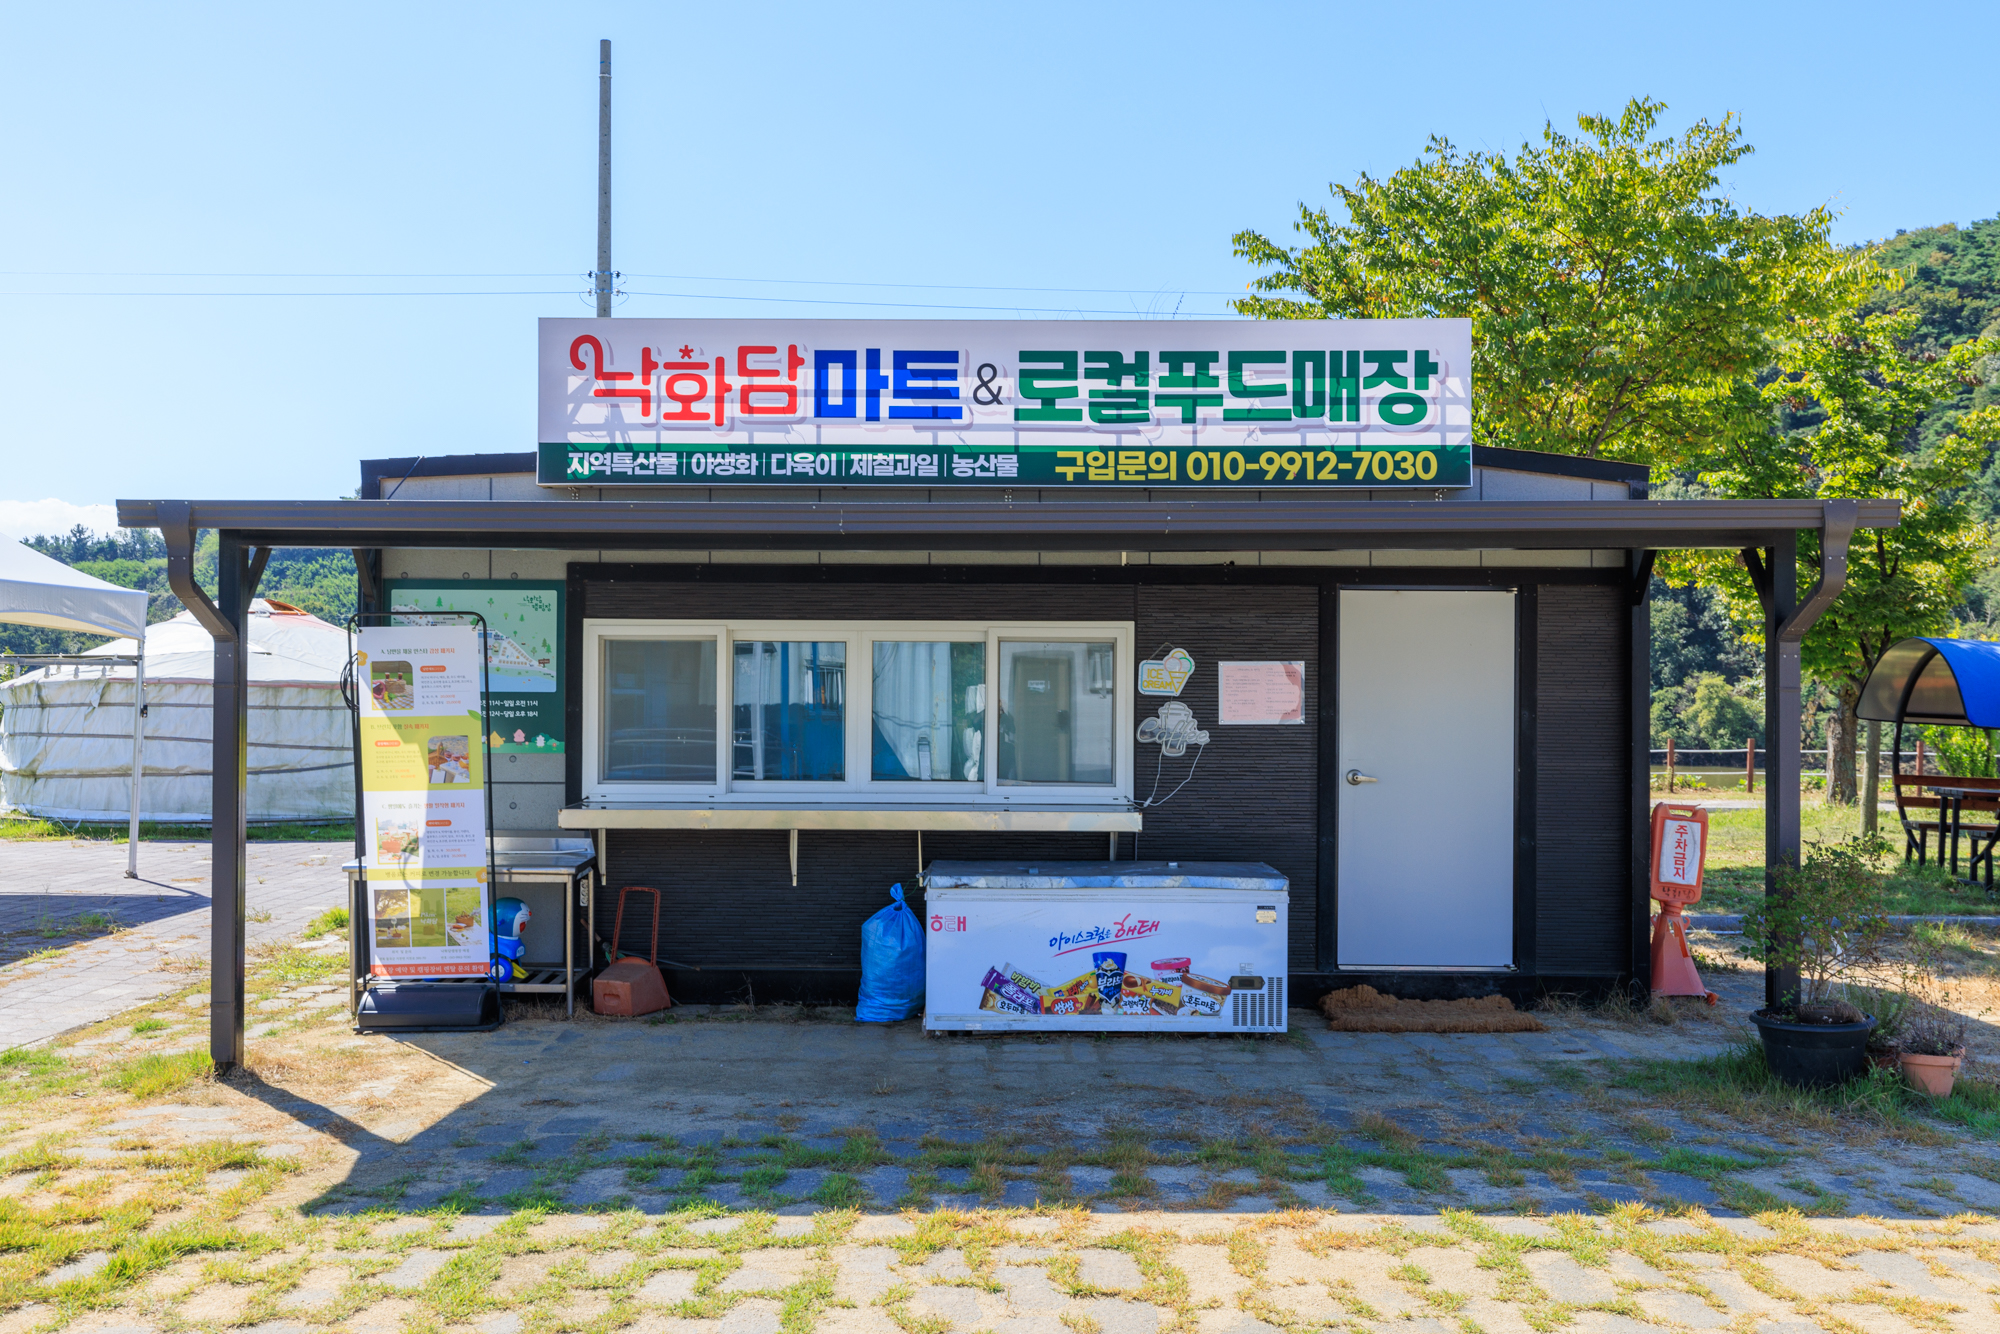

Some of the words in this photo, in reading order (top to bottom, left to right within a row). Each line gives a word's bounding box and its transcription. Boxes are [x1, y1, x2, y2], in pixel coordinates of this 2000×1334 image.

[570, 334, 805, 427] 낙화담
[813, 348, 963, 422] 마트
[972, 362, 1003, 406] &
[1014, 350, 1438, 425] 로컬푸드매장
[567, 452, 678, 475] 지역특산물
[691, 453, 758, 476] 야생화
[771, 453, 836, 476] 다육이
[850, 453, 938, 477] 제철과일
[952, 454, 1018, 477] 농산물
[1055, 451, 1177, 481] 구입문의
[1186, 451, 1438, 481] 010-9912-7030
[532, 603, 551, 612] 캠핑장
[1142, 679, 1172, 690] CREAM
[1147, 668, 1164, 679] ICE
[1137, 719, 1209, 750] Coffee
[1673, 824, 1688, 880] 주차금지
[1049, 926, 1111, 950] 아이스크림은
[1113, 913, 1161, 939] 해태
[1001, 981, 1034, 1008] 폴라포
[1011, 971, 1041, 994] 바밤바
[1098, 975, 1123, 991] 부라보
[1149, 985, 1173, 997] 누가바
[1187, 994, 1217, 1012] 호두마루
